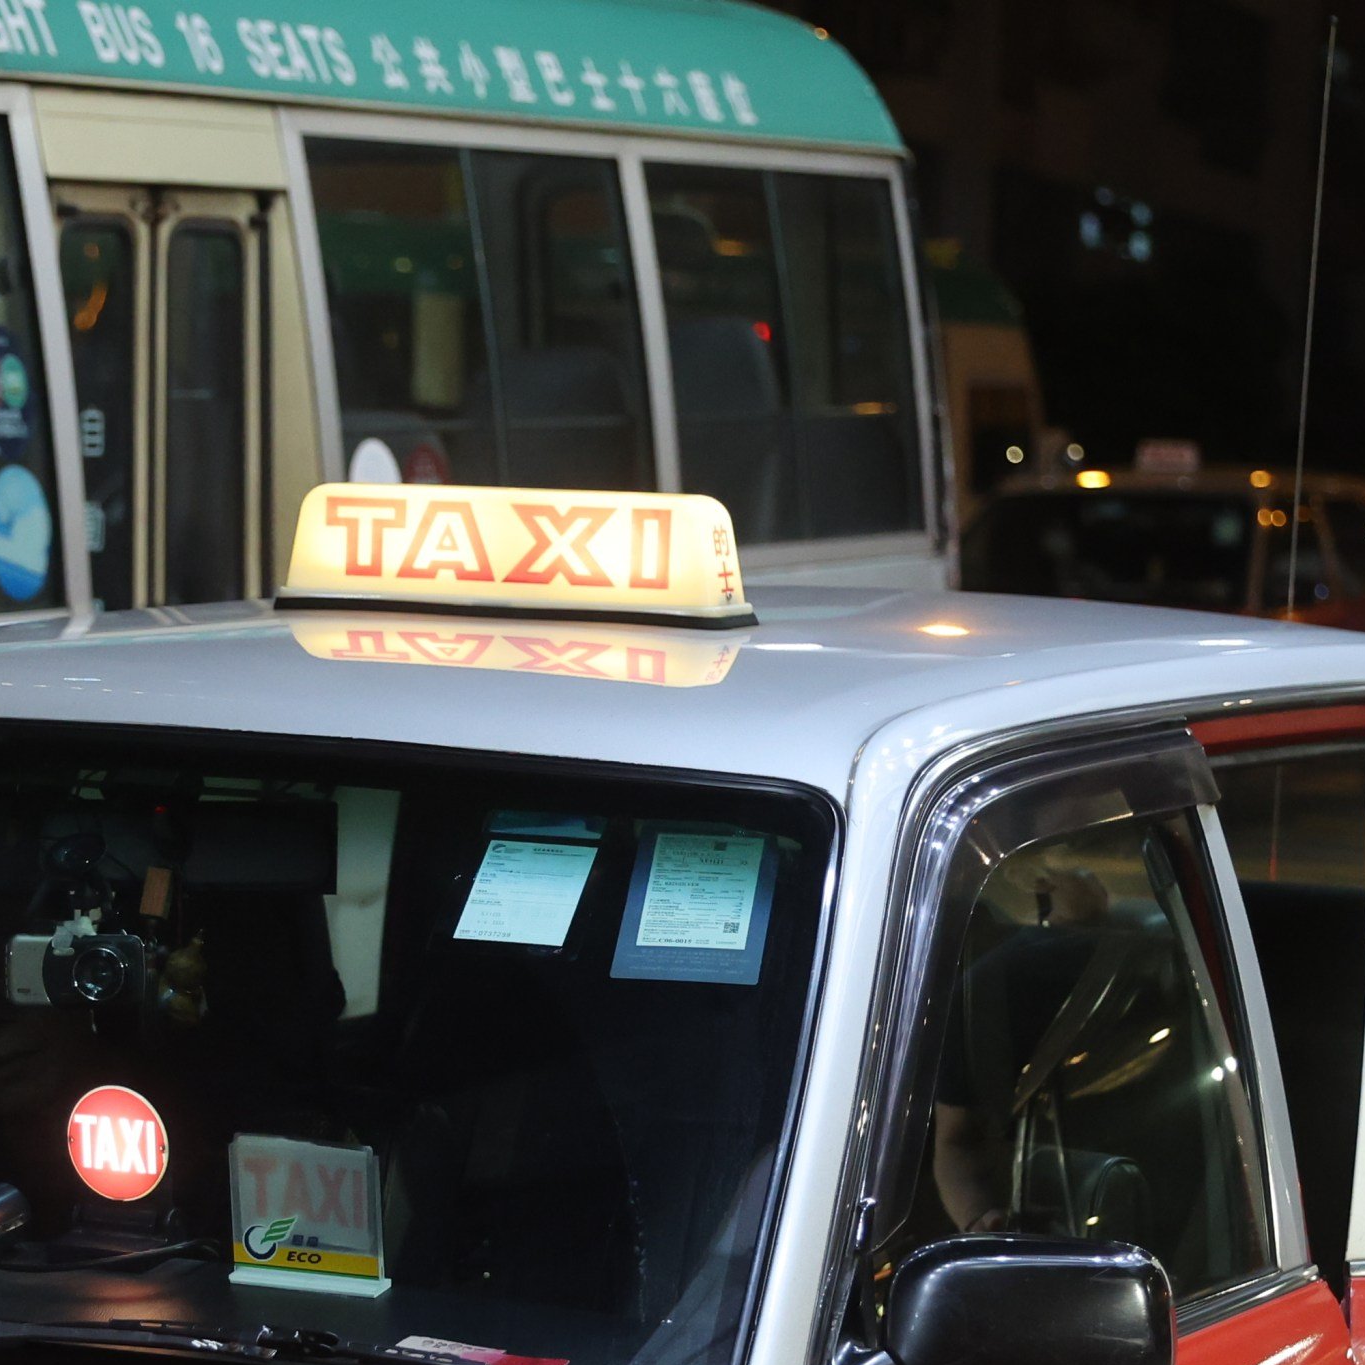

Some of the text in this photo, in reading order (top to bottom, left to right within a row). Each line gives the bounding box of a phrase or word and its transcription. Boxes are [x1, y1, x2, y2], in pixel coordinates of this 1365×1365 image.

[77, 0, 165, 68] BUS
[175, 11, 225, 75] 16
[236, 17, 357, 86] SEATS
[326, 496, 672, 590] TAXI
[712, 524, 735, 594] 的士
[73, 1114, 158, 1175] TAXI
[243, 1157, 365, 1228] TAXI
[287, 1250, 322, 1264] ECO
